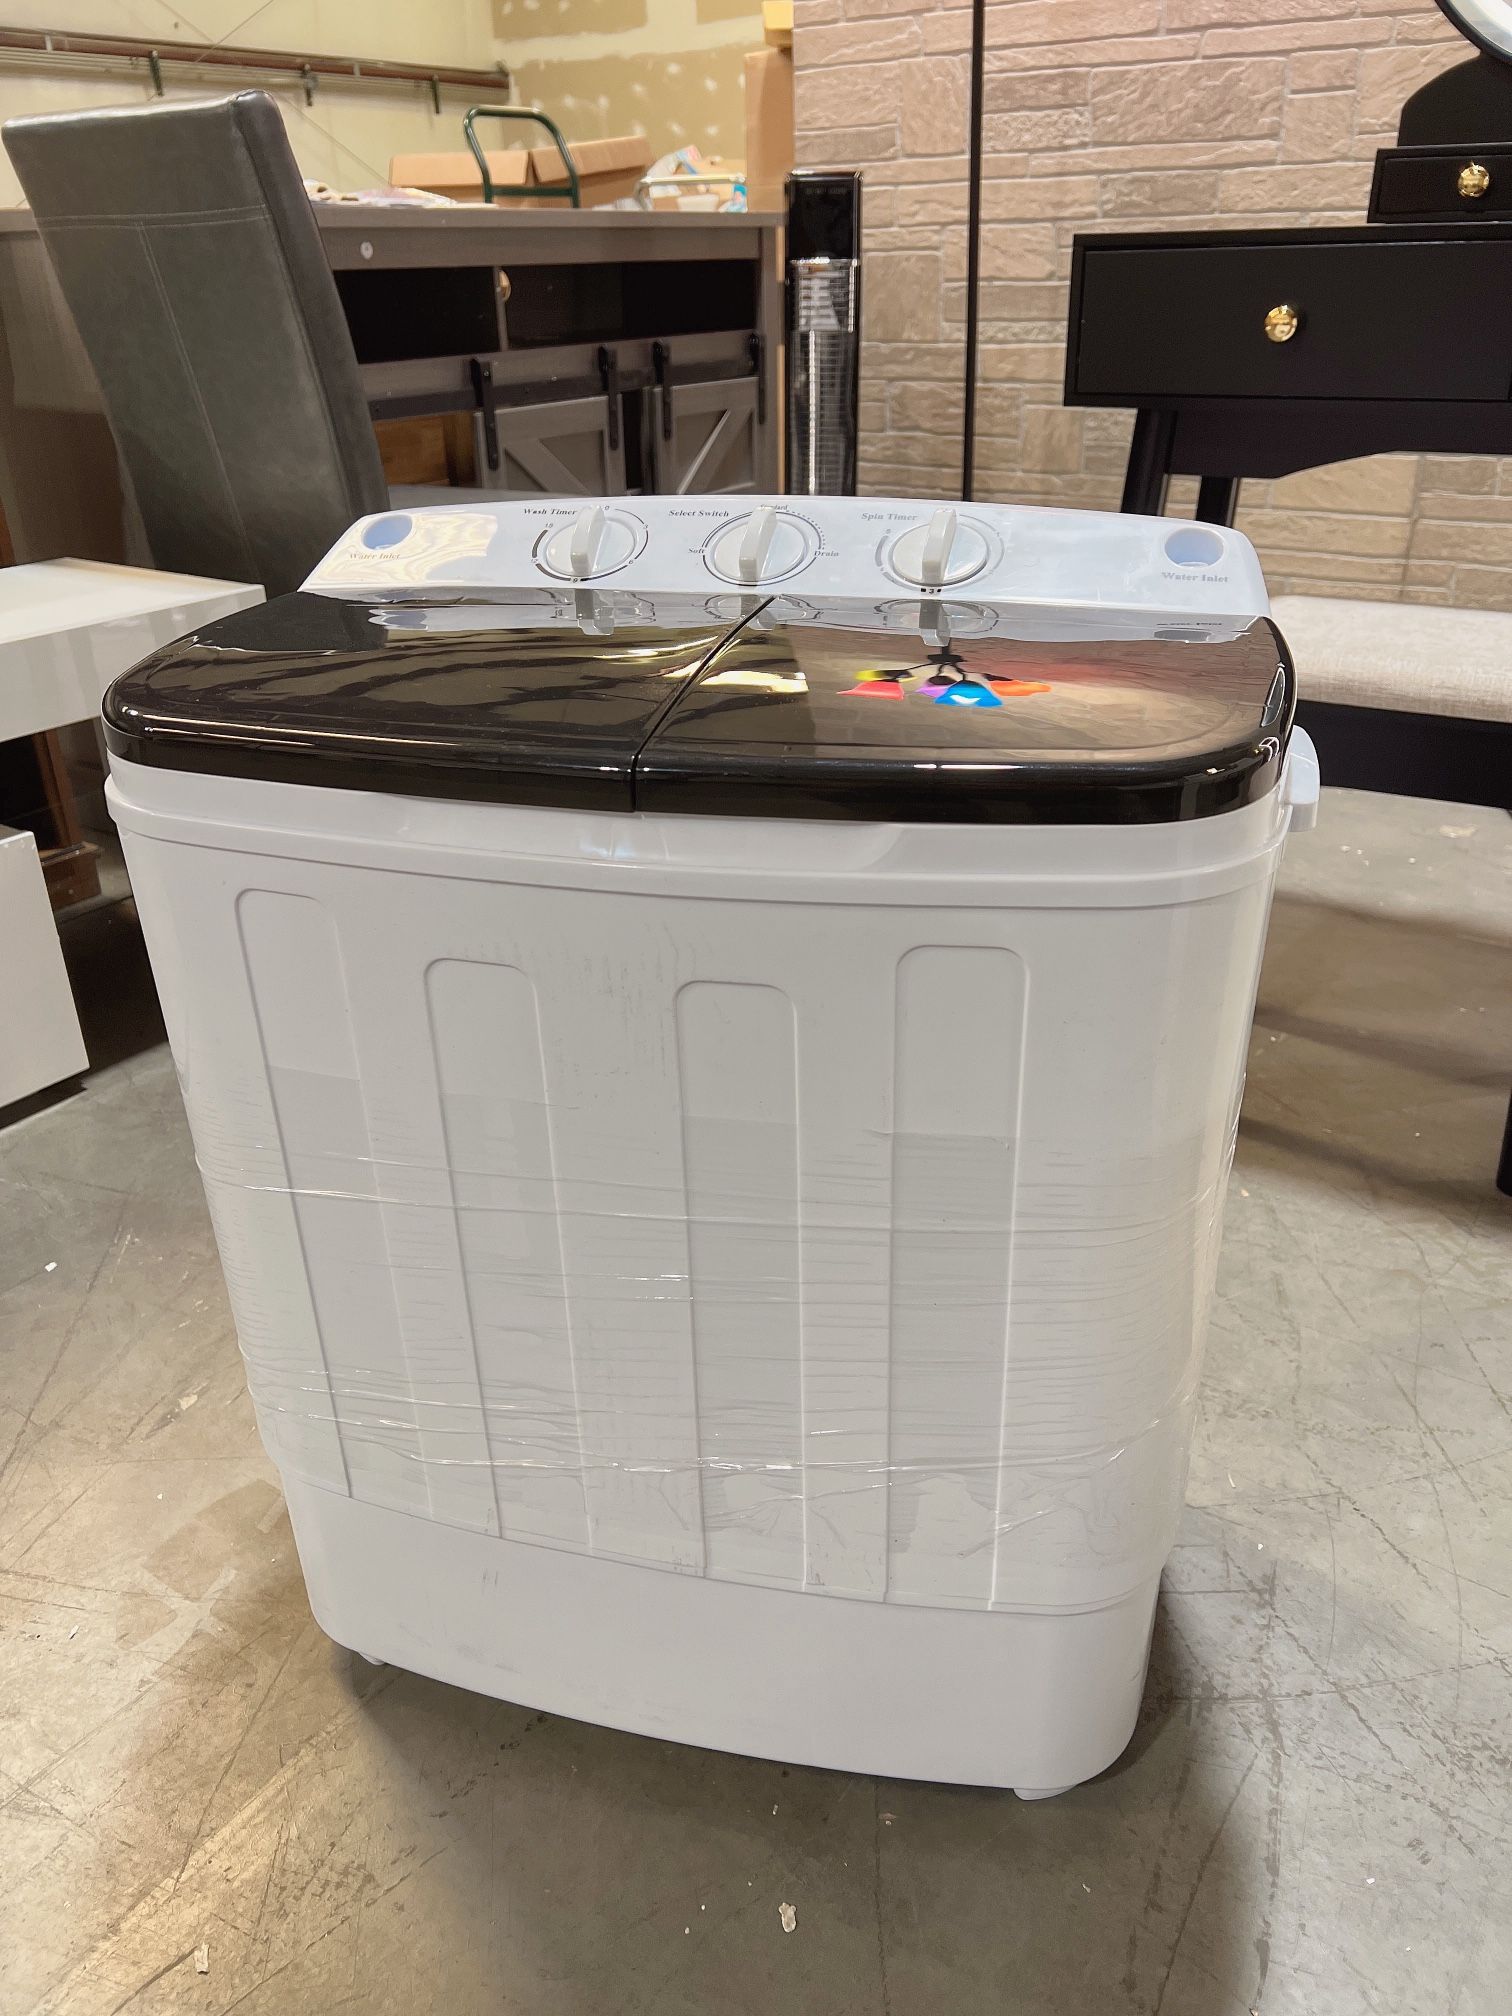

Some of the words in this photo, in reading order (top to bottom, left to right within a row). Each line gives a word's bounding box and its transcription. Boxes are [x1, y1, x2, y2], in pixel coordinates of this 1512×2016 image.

[668, 509, 695, 517] Select
[699, 509, 730, 517] Switch
[861, 513, 884, 521] Spin
[888, 513, 919, 521] Timer
[350, 552, 377, 560] Water
[379, 552, 401, 560] Inlet
[1161, 572, 1199, 581] Water
[1202, 573, 1229, 583] Inlet
